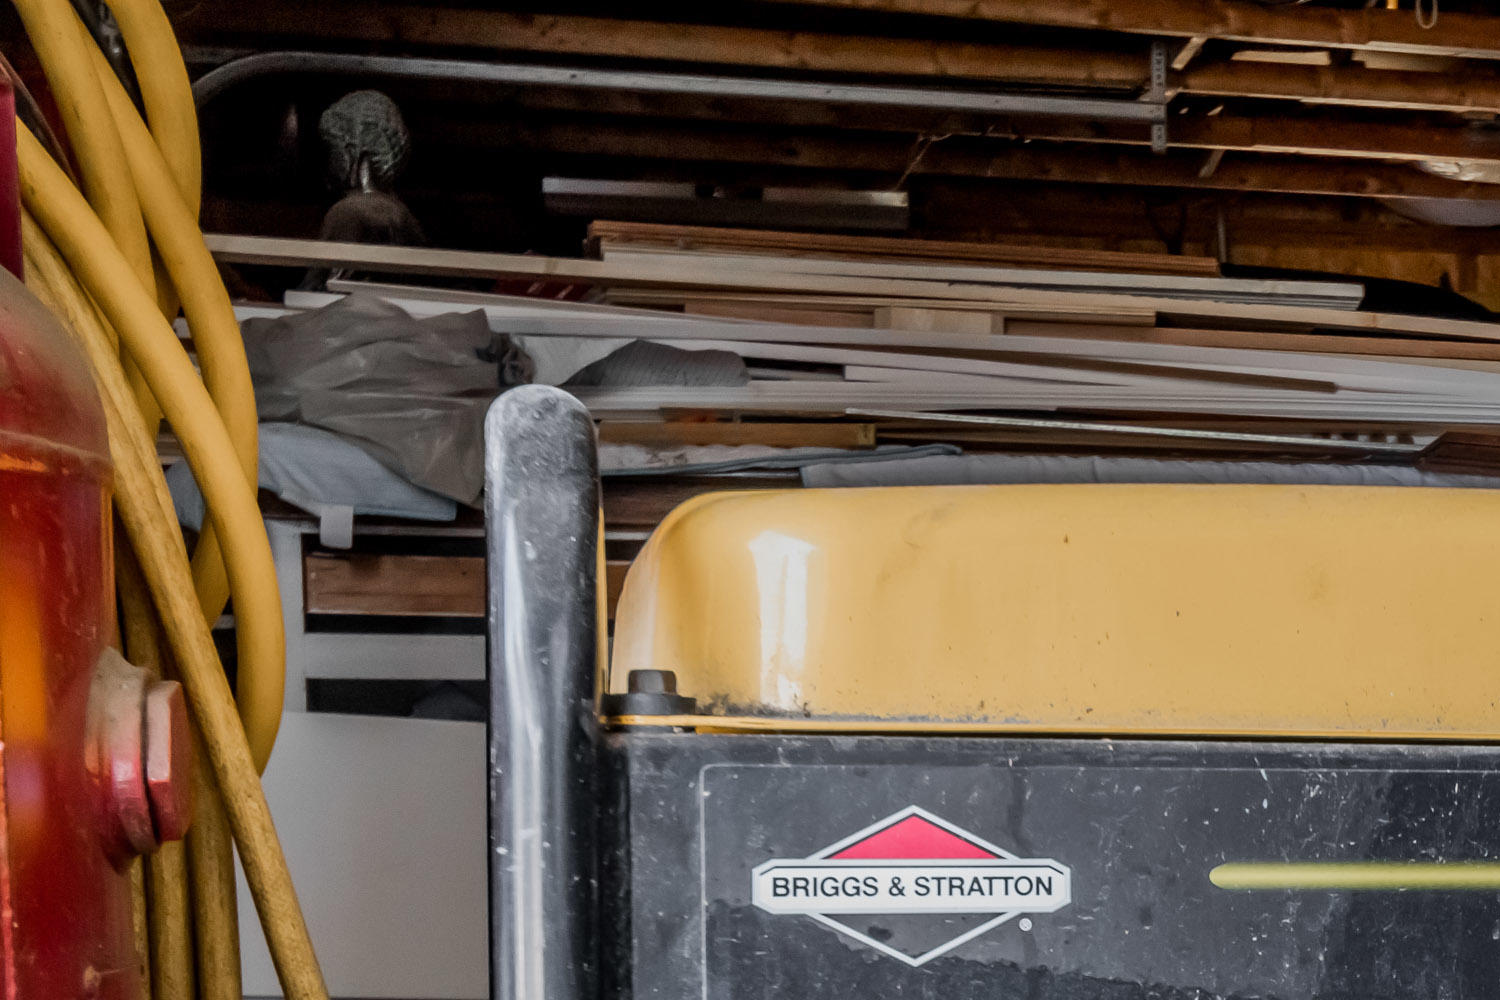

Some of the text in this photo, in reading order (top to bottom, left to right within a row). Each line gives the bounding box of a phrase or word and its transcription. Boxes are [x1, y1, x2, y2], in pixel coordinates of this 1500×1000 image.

[772, 875, 1053, 898] BRIGGS & STRATTON
